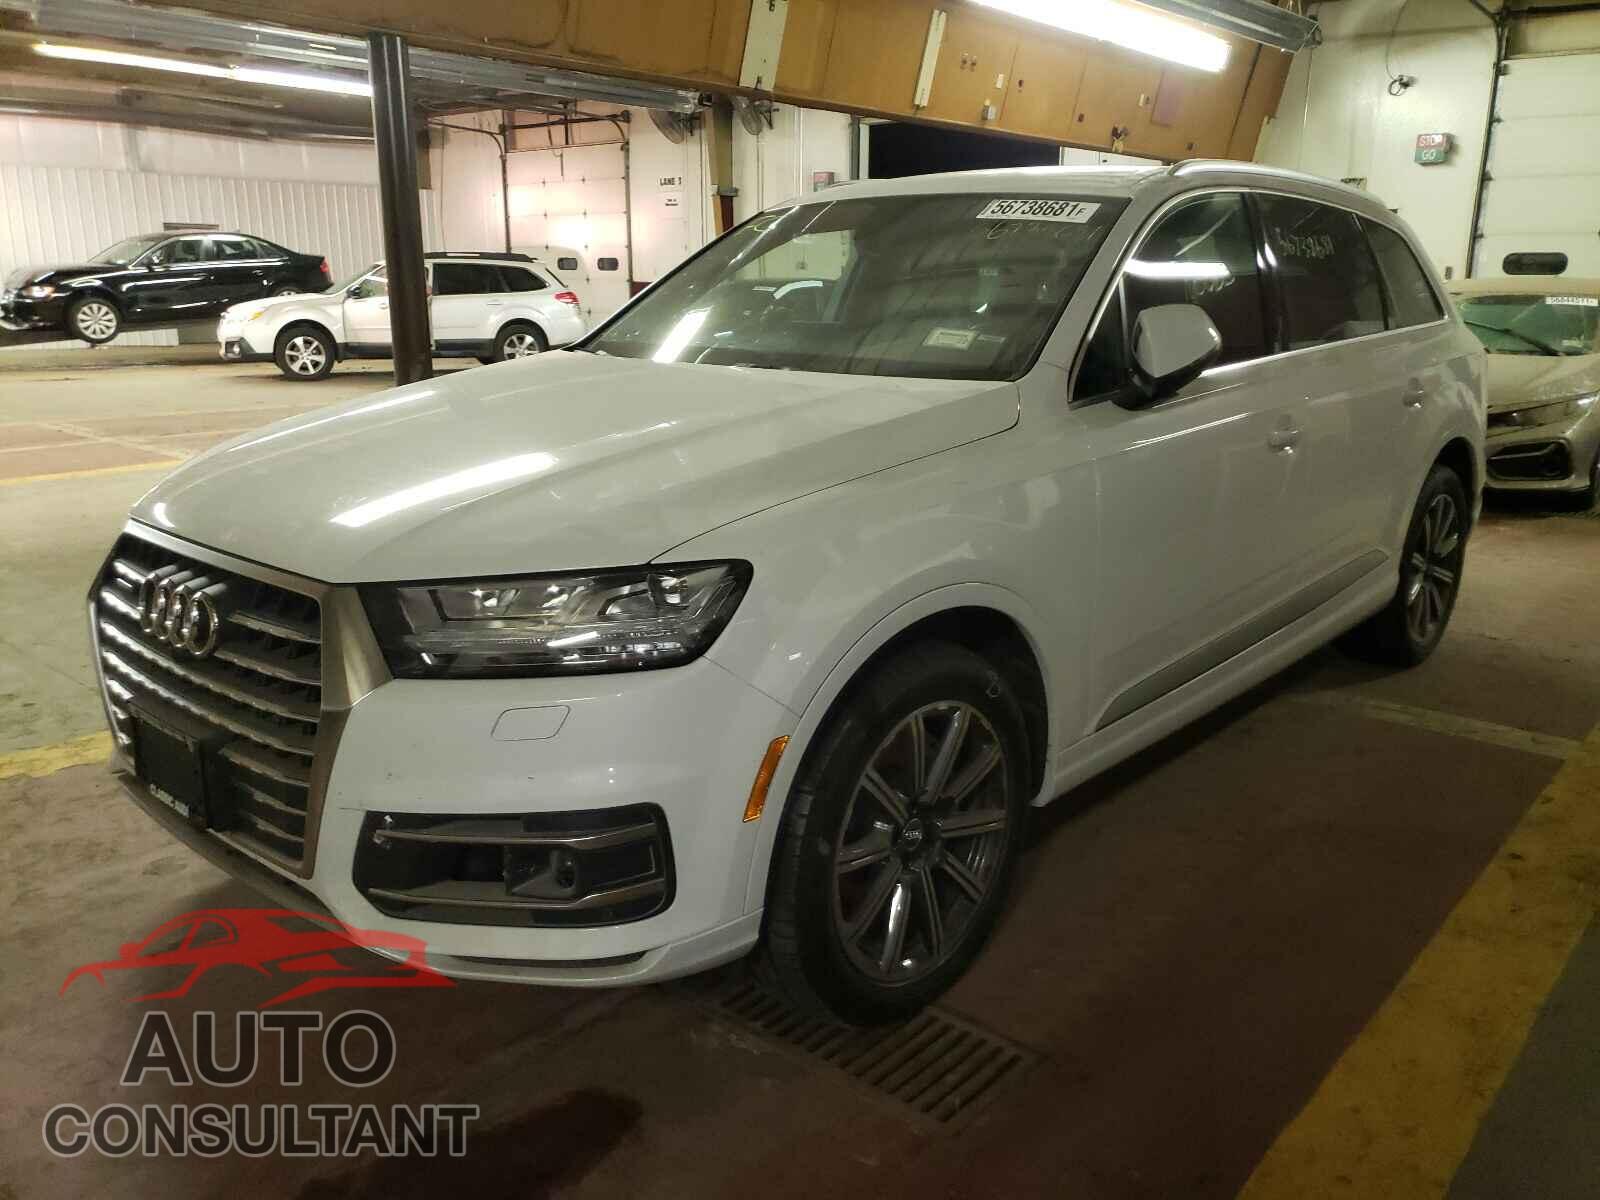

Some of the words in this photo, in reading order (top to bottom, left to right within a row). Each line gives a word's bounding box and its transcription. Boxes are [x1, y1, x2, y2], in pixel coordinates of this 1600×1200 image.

[1419, 135, 1443, 147] STOP
[1422, 149, 1437, 161] GO
[659, 177, 675, 186] LANE
